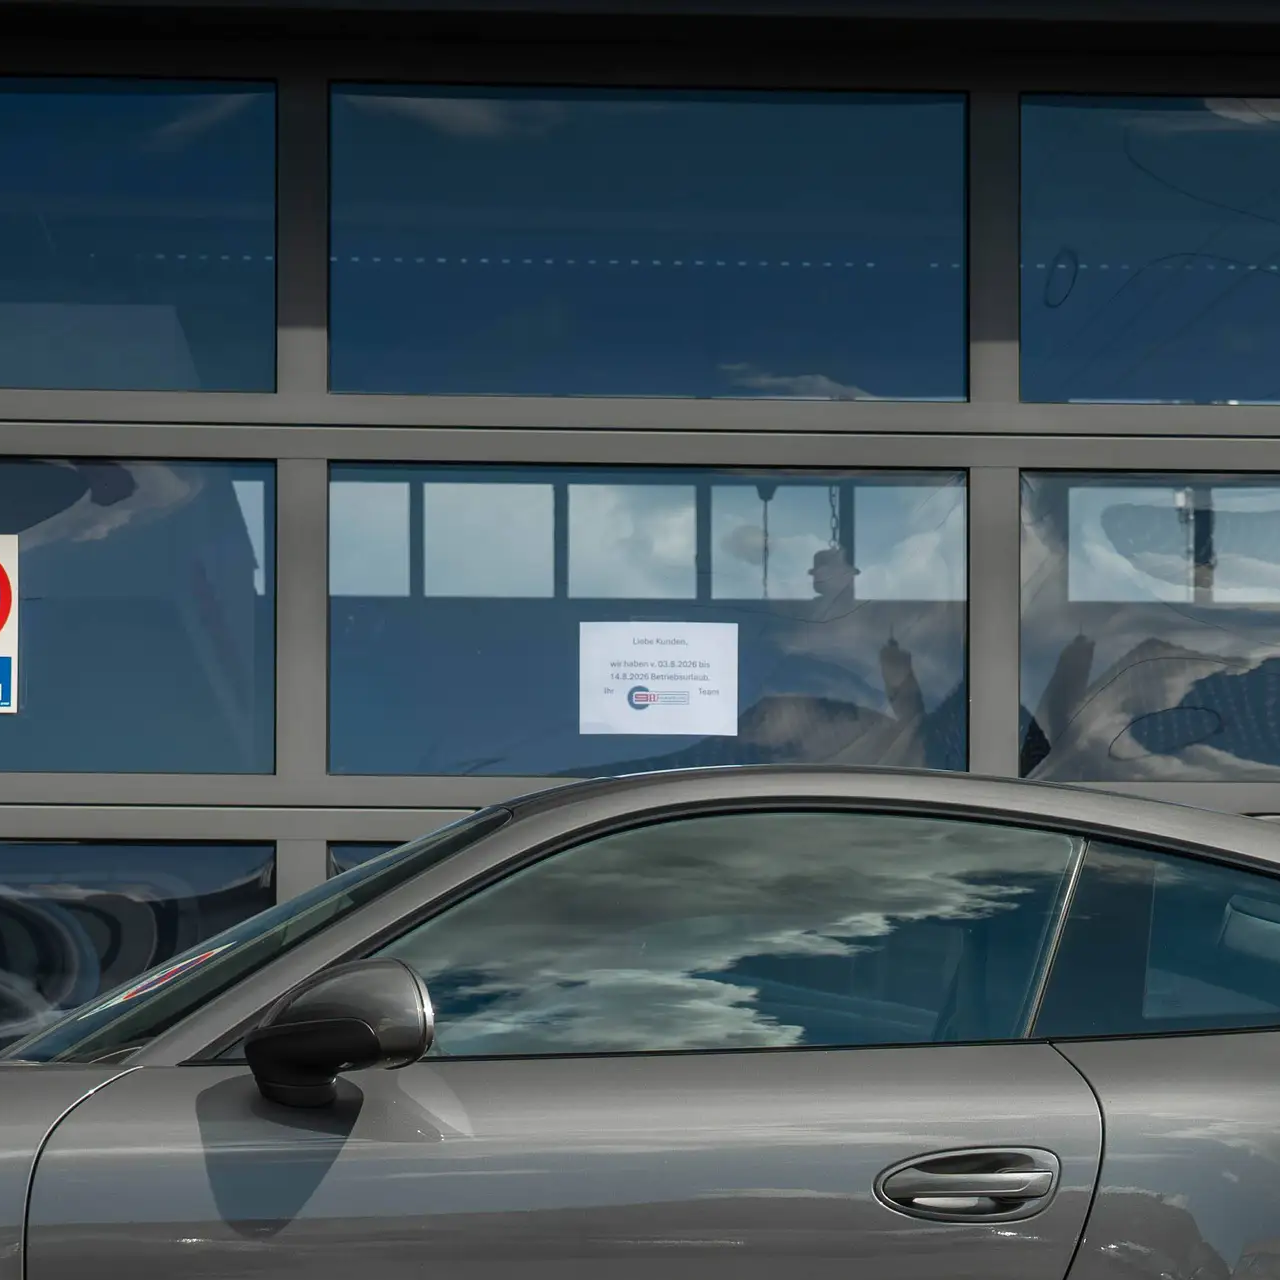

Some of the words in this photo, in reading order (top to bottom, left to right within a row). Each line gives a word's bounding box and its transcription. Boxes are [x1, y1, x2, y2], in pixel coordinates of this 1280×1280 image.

[632, 637, 654, 646] Liebe
[609, 660, 623, 669] wir
[623, 660, 649, 669] haben
[698, 660, 711, 669] bis
